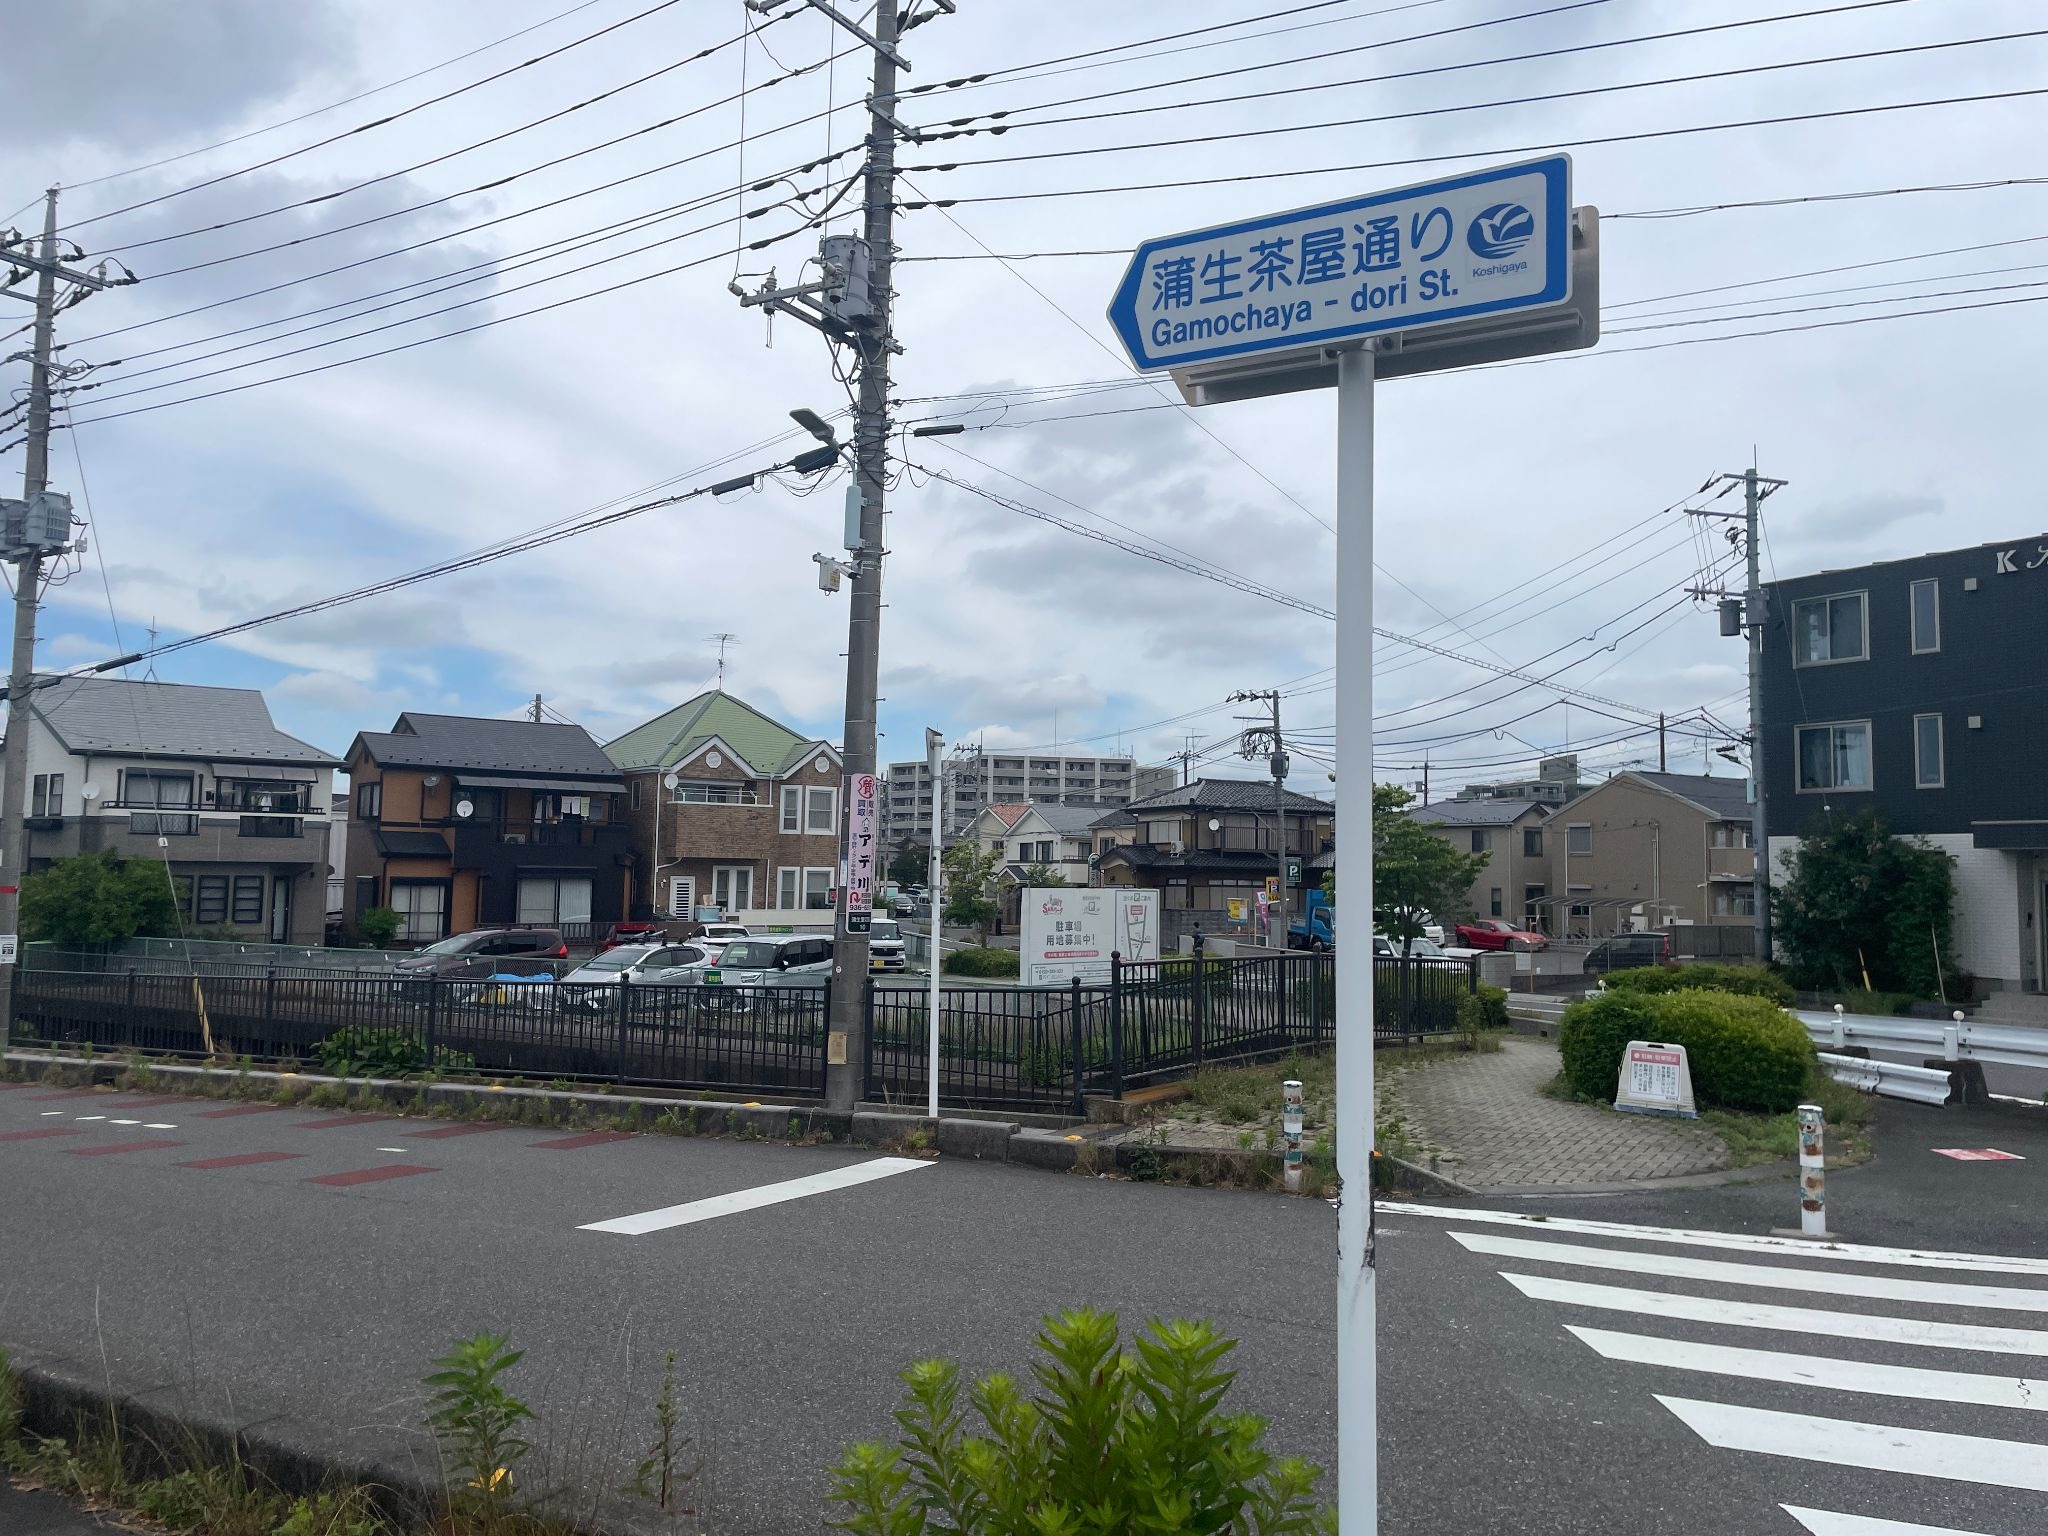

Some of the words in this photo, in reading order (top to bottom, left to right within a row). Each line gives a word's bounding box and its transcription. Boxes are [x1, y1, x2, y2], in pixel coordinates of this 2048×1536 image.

[1152, 206, 1454, 311] 蒲生茶屋通り
[1472, 261, 1528, 277] Koshigaya
[1151, 299, 1313, 347] Gamochaya
[1350, 274, 1407, 314] dori
[1418, 268, 1459, 302] St.
